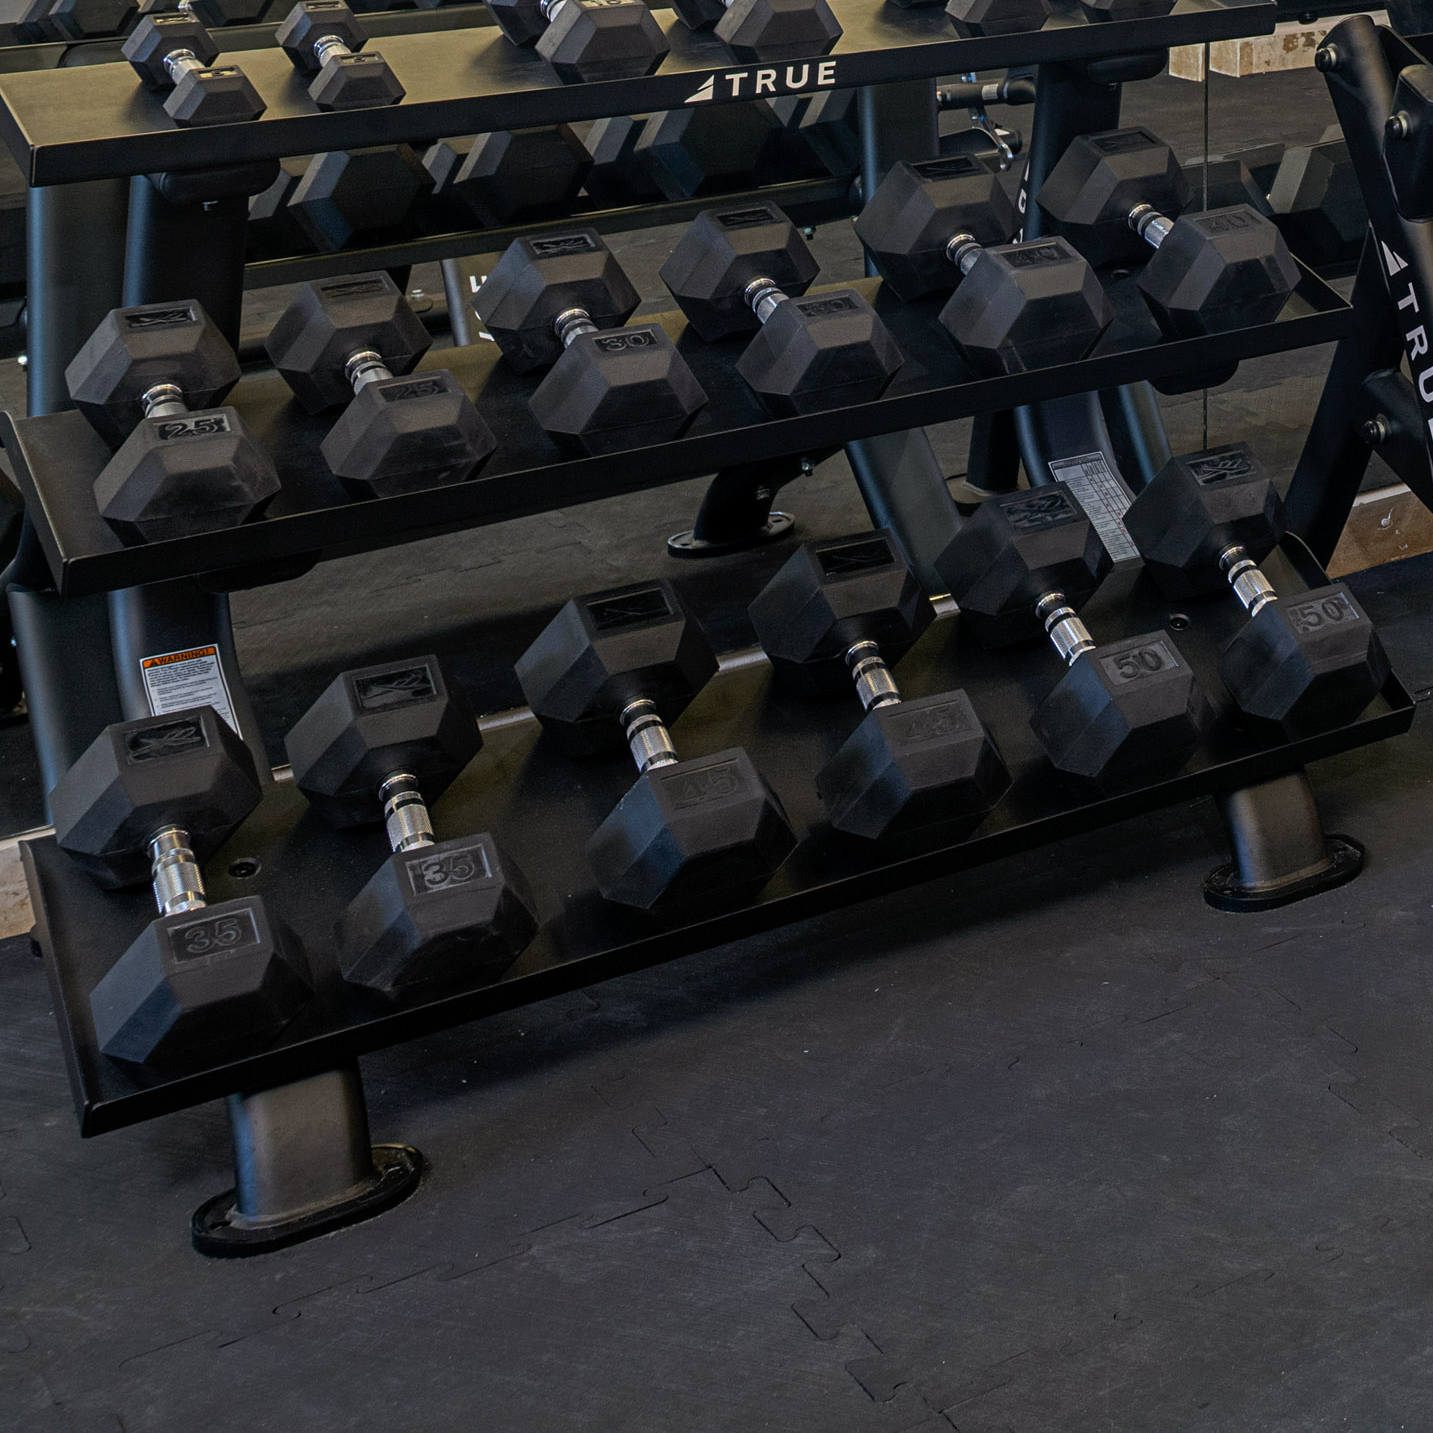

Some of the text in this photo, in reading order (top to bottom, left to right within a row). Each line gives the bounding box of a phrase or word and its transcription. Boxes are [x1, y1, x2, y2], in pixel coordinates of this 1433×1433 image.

[725, 61, 837, 98] TRUE
[604, 333, 649, 351] 30
[166, 418, 218, 440] 25
[1301, 593, 1348, 625] 50
[158, 647, 209, 665] WARNING!
[1117, 648, 1164, 678] 50
[421, 854, 476, 886] 35
[183, 917, 243, 954] 35
